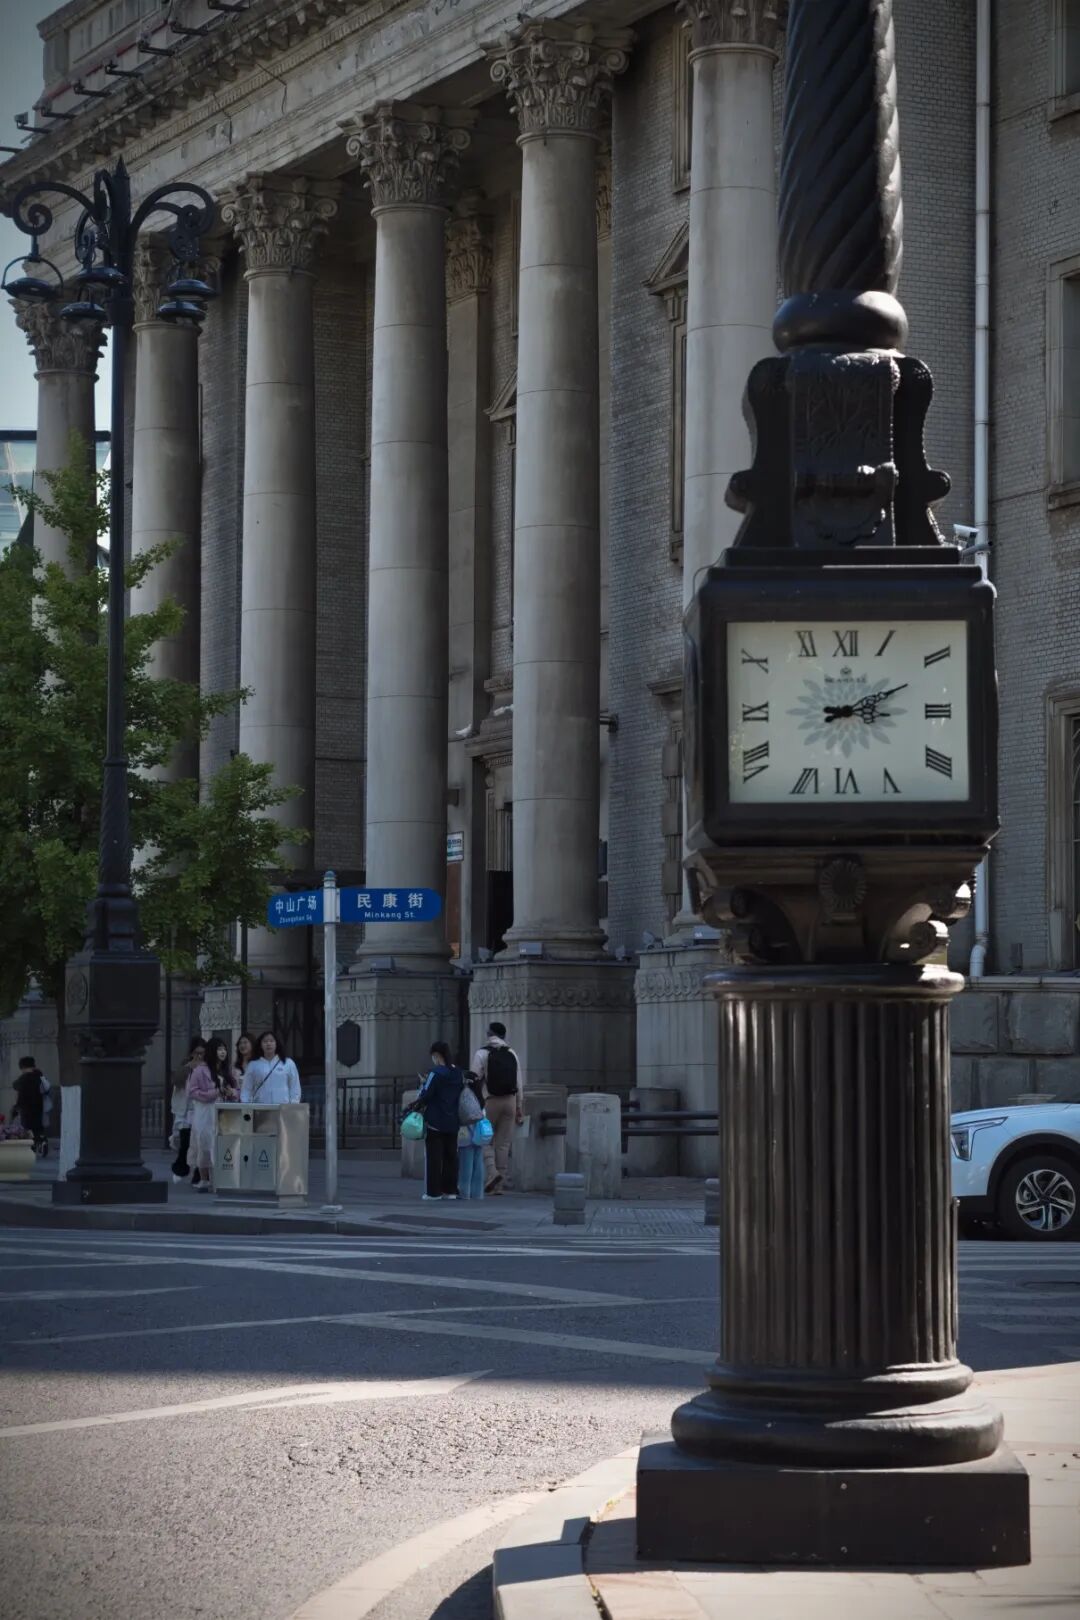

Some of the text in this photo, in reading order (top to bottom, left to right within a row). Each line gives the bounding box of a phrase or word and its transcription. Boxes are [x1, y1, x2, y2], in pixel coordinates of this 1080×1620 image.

[832, 630, 859, 657] XII
[275, 895, 317, 914] 中山广场
[357, 893, 423, 908] 民康街
